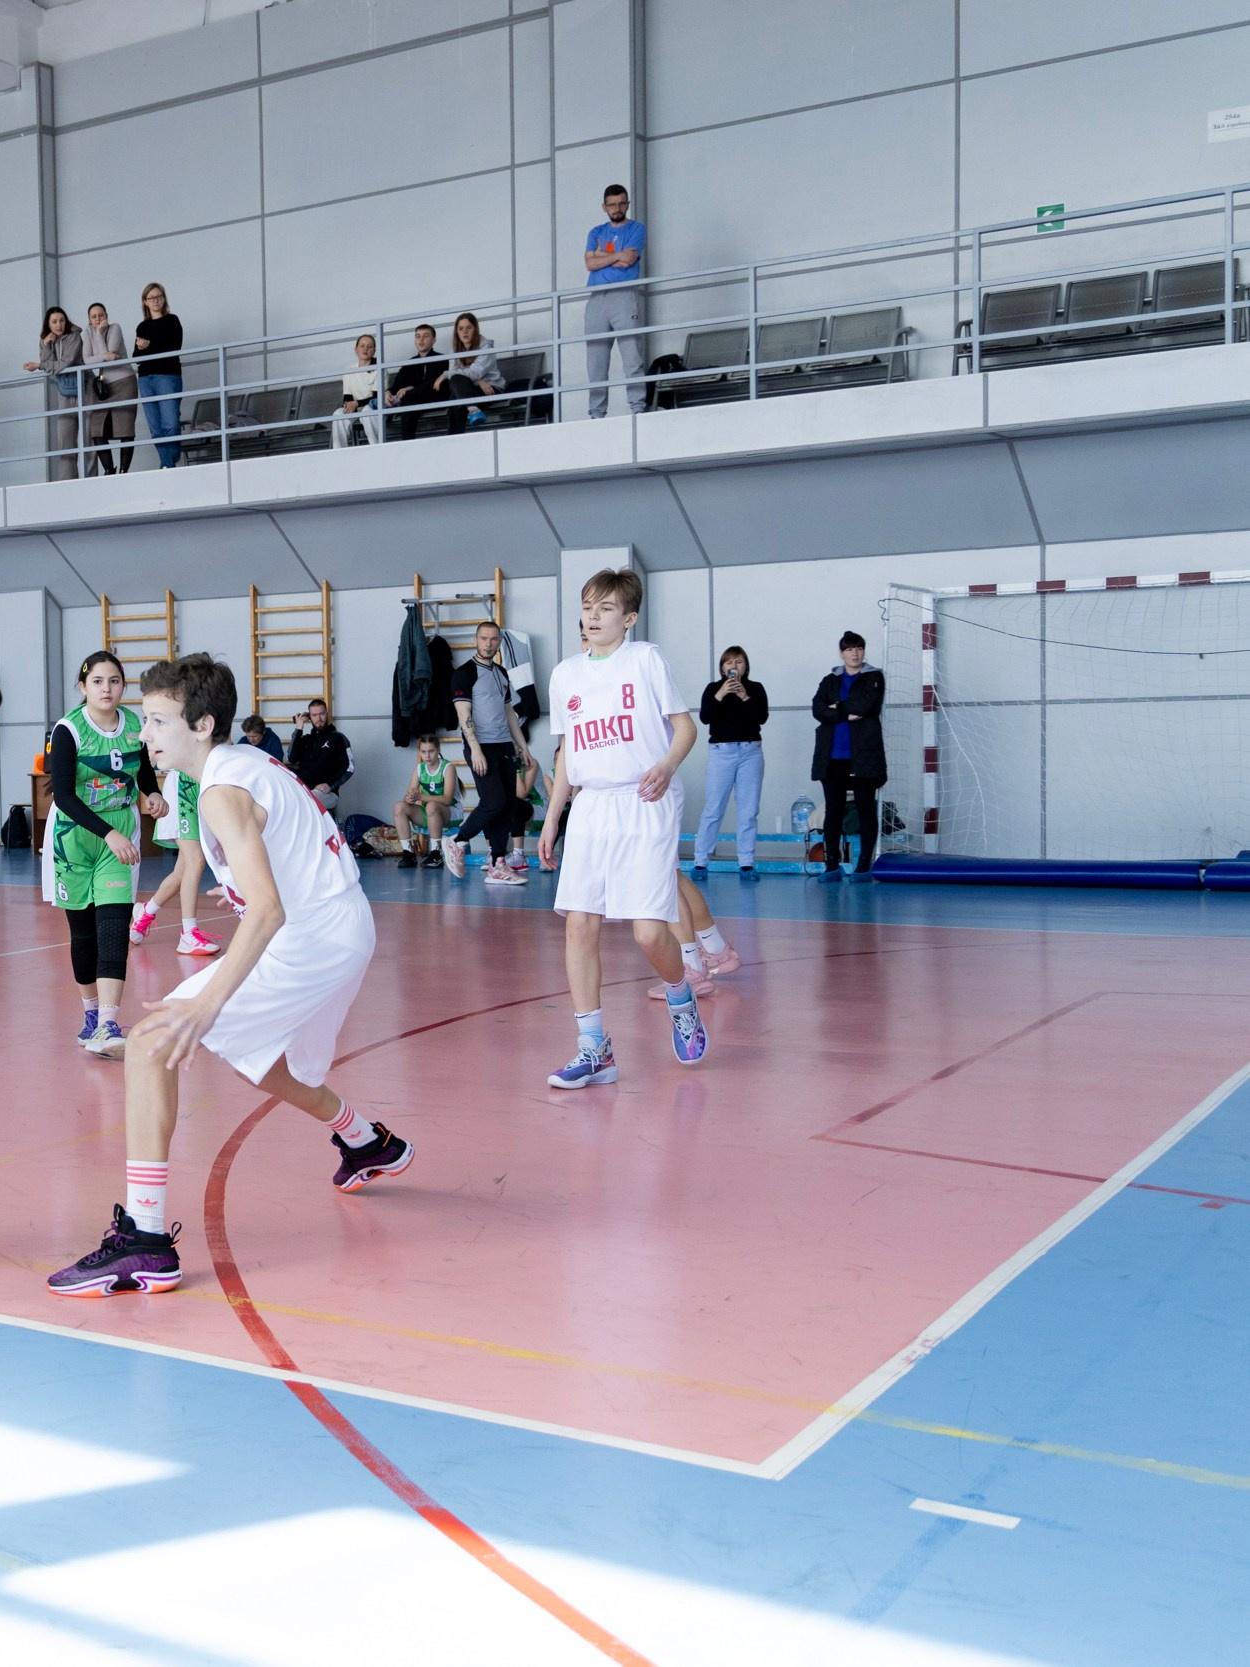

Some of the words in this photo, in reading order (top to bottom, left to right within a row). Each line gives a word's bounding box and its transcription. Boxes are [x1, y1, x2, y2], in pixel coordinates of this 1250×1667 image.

[621, 683, 636, 710] 8
[573, 714, 635, 753] ЛОКО
[588, 737, 620, 751] БАСКЕТ
[109, 748, 124, 771] 6
[429, 781, 436, 792] 9
[180, 819, 190, 834] 3
[57, 881, 70, 902] 6
